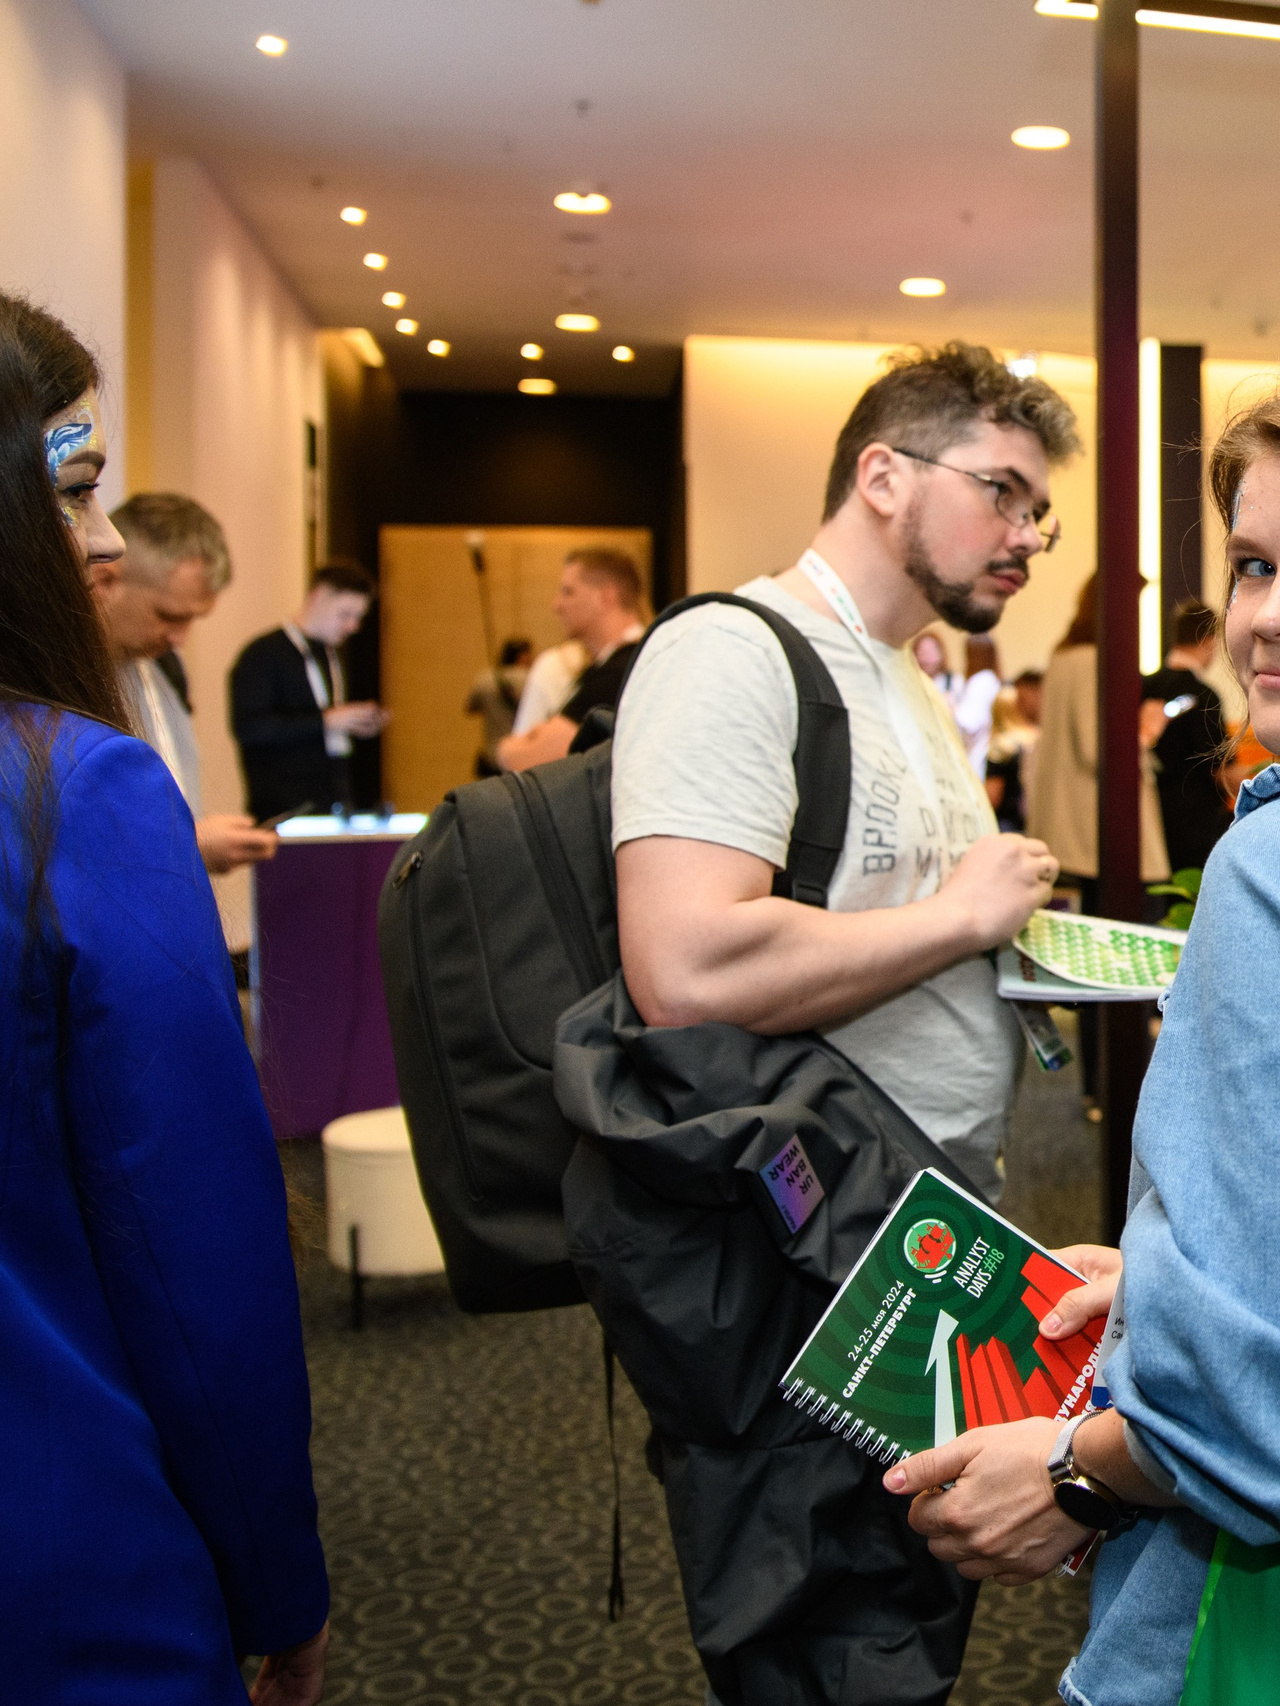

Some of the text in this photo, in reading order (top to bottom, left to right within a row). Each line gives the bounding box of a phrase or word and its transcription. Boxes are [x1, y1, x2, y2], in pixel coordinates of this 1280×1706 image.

[768, 1144, 800, 1181] WEAR
[785, 1158, 807, 1188] BAN
[798, 1174, 814, 1195] UR
[952, 1236, 991, 1289] ANALYST
[842, 1287, 917, 1398] САНКТ-ПЕТЕРБУРГ
[847, 1280, 905, 1362] 24-25 мая 2024
